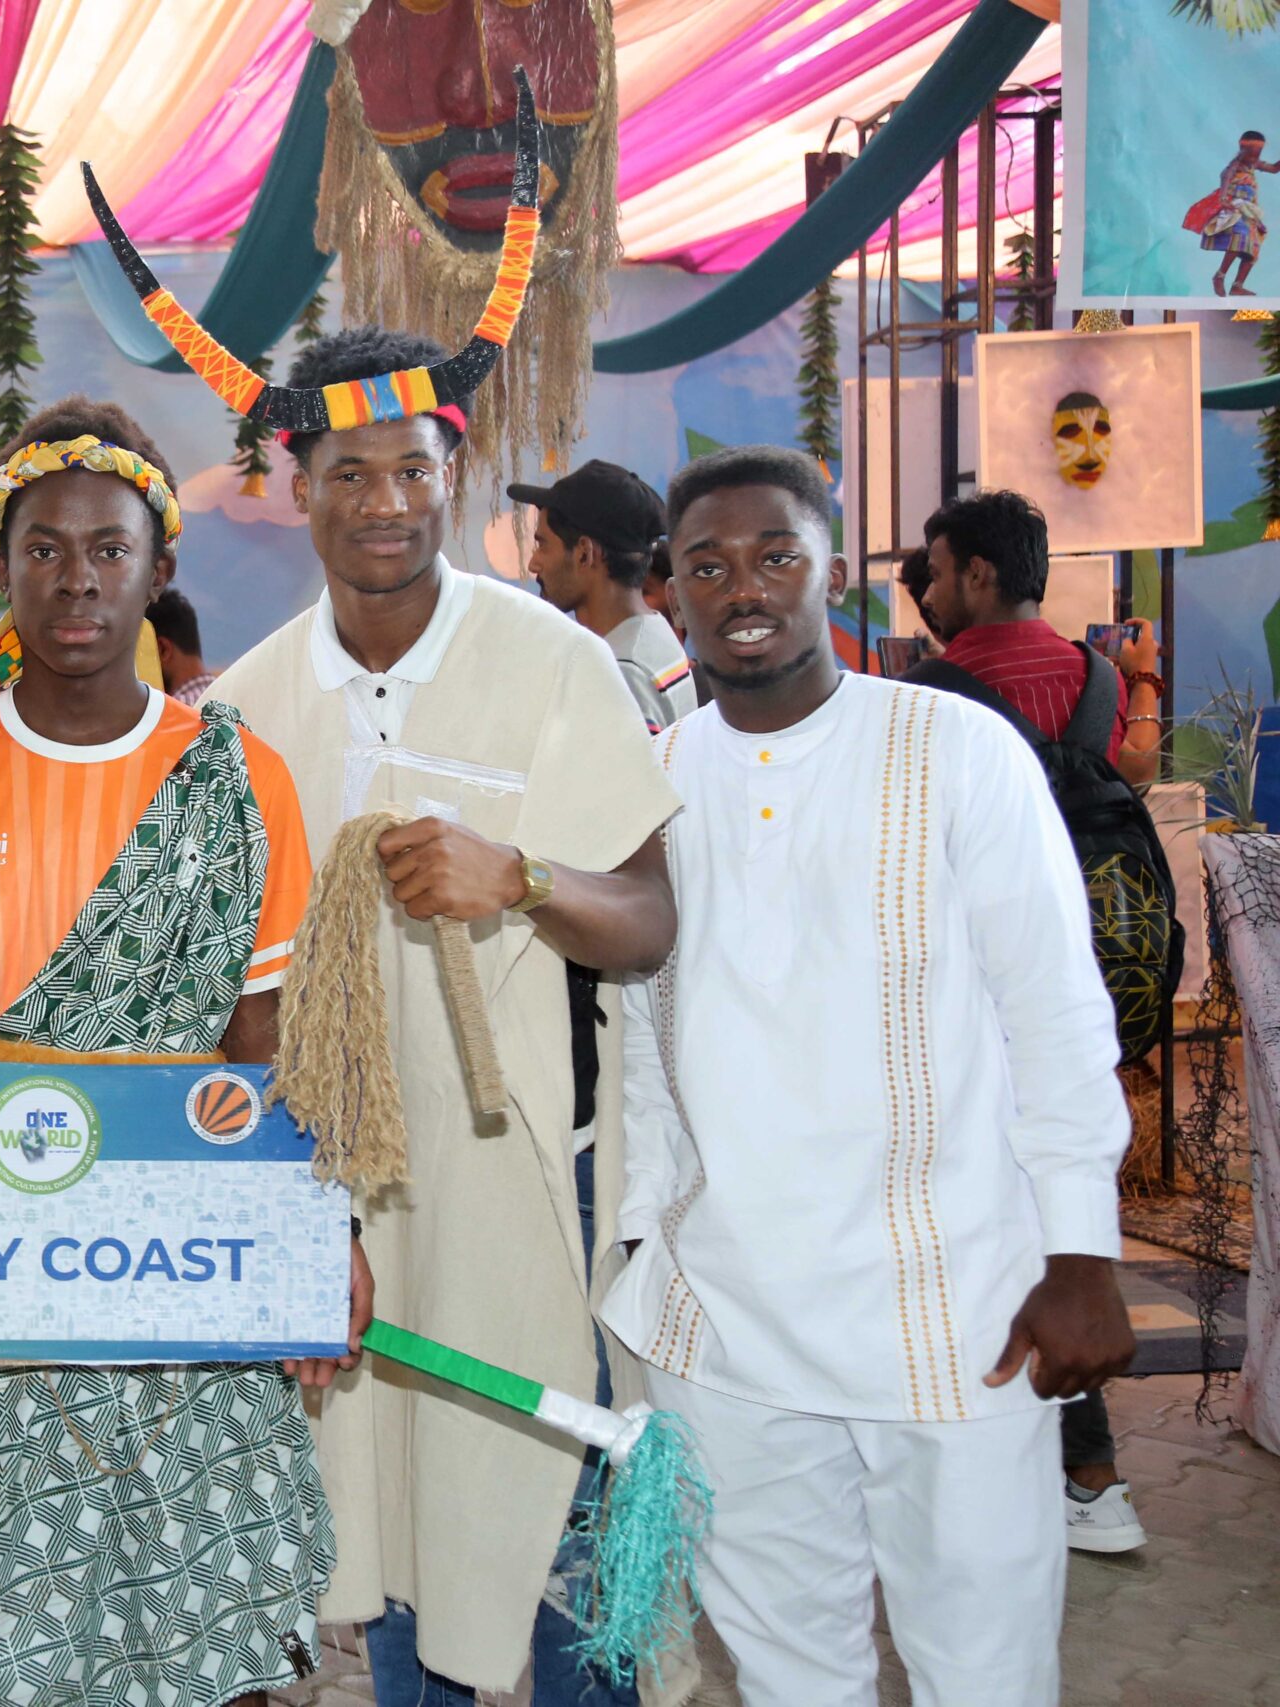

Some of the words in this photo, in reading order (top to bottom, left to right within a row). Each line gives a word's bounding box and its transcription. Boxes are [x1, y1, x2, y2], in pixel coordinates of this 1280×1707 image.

[56, 1080, 78, 1097] YOUTH
[77, 1094, 96, 1123] FESTIVAL
[26, 1111, 68, 1128] ONE
[16, 1180, 54, 1191] CULTURAL
[53, 1163, 87, 1189] DIVERSITY
[41, 1237, 255, 1281] COAST
